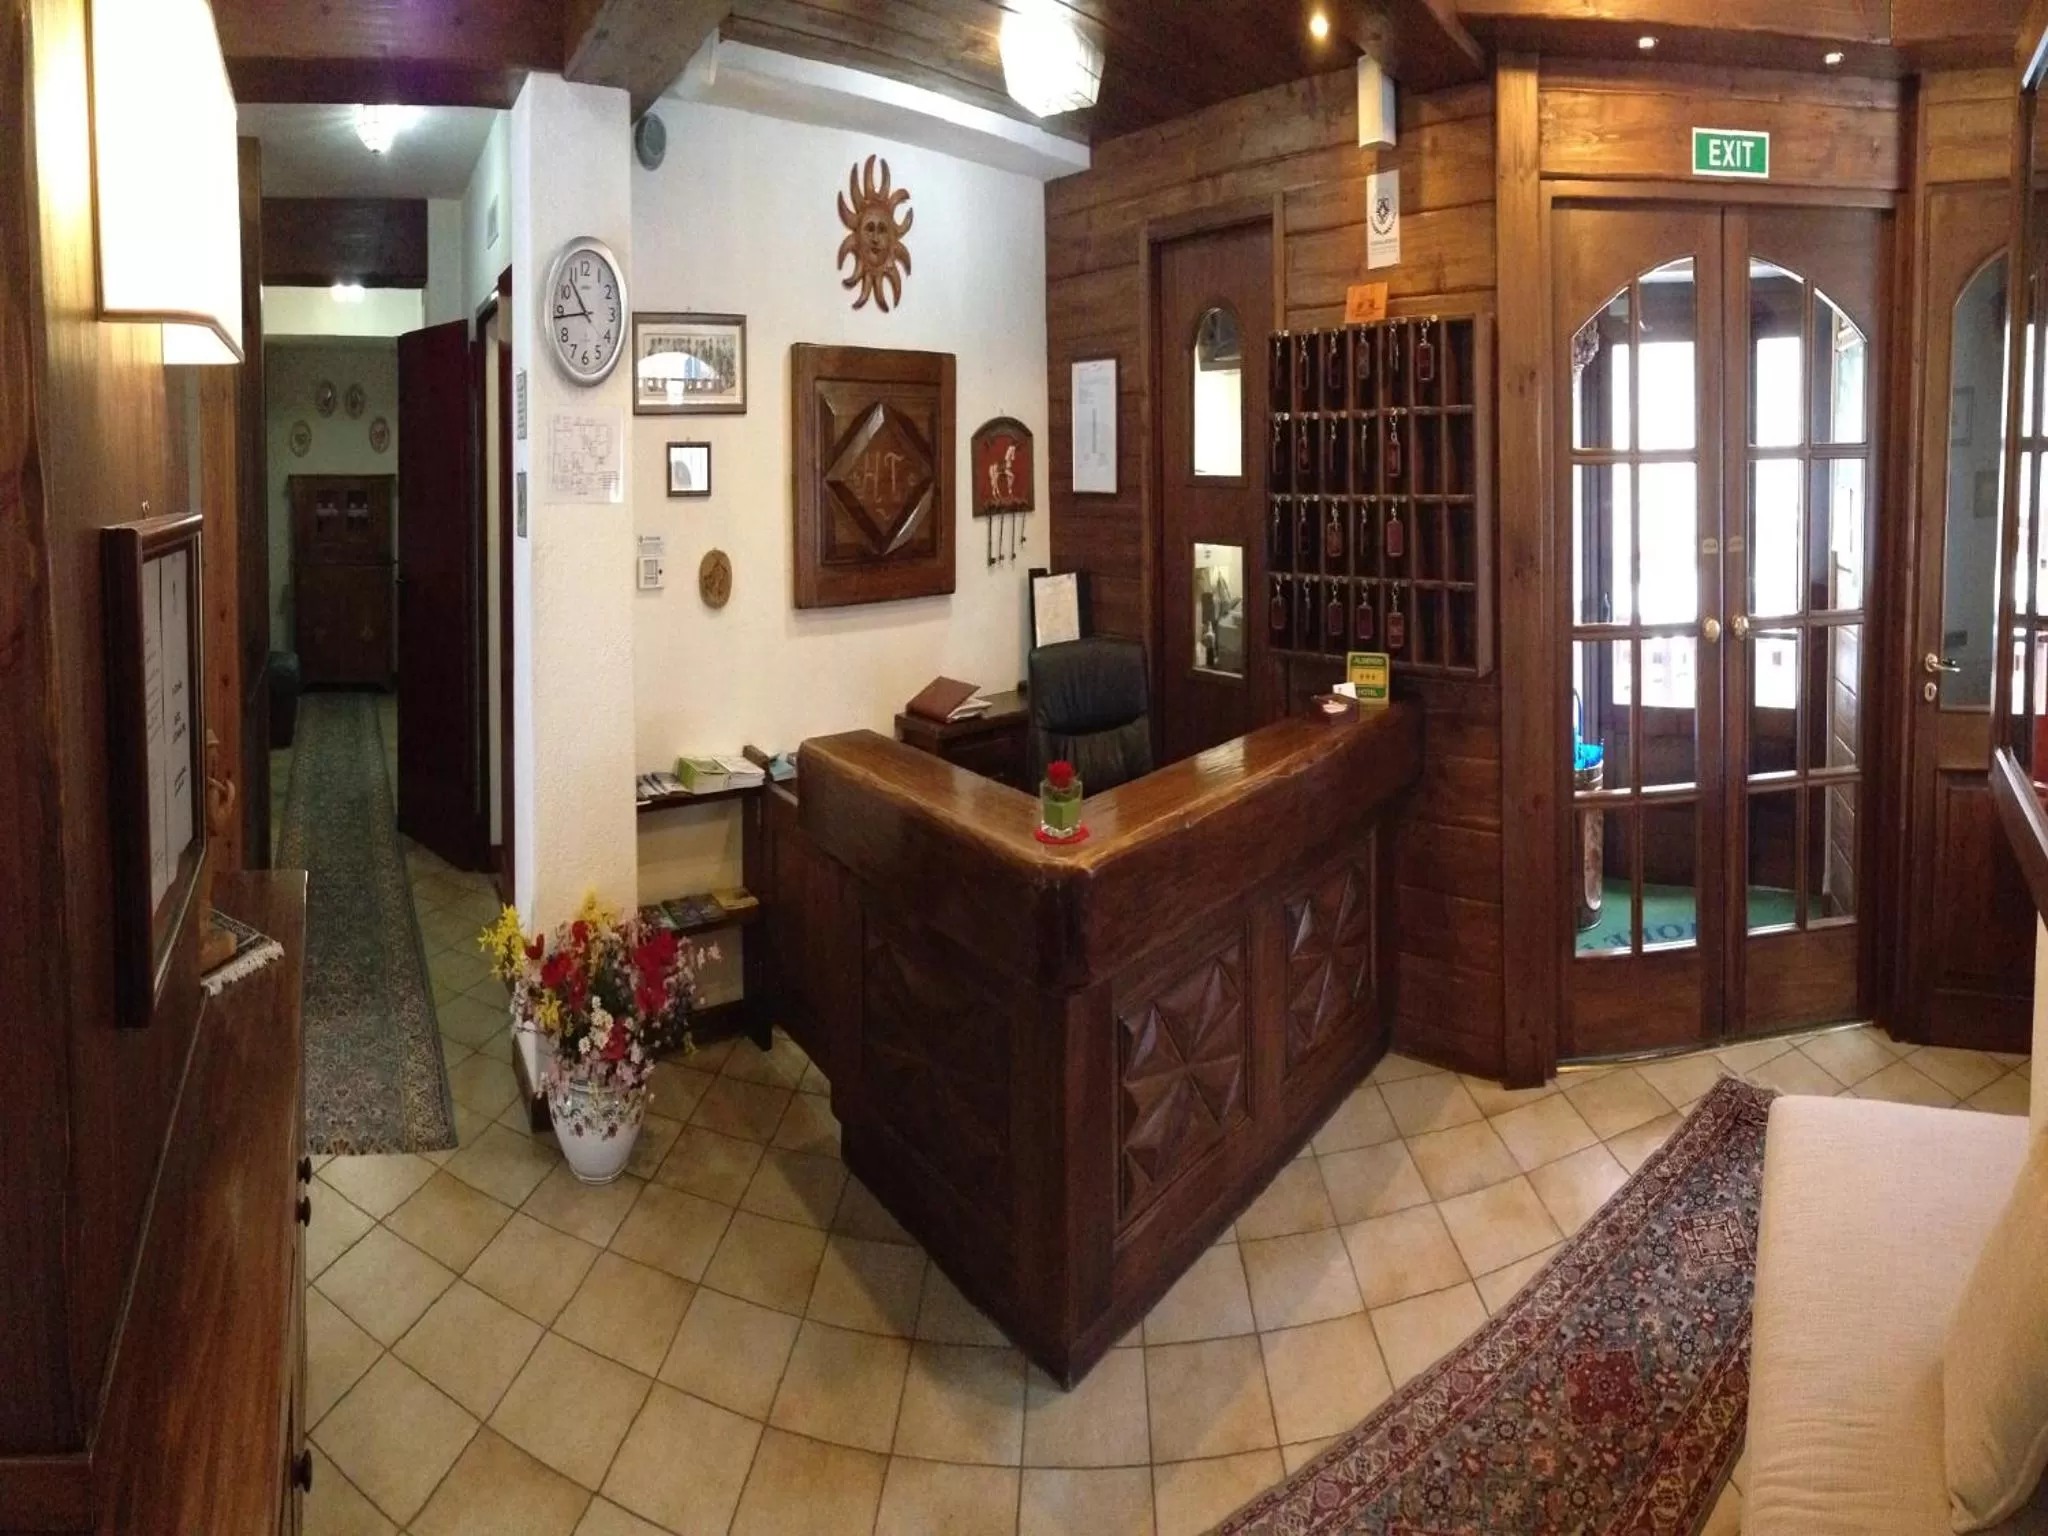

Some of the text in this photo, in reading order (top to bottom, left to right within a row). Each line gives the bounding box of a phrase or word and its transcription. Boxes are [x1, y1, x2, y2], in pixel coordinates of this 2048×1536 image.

[1709, 139, 1755, 168] EXIT
[580, 260, 591, 277] 12
[561, 284, 572, 300] 10
[604, 284, 613, 300] 2
[556, 304, 565, 318] 9
[608, 308, 616, 323] 3
[560, 327, 569, 343] 8
[603, 330, 611, 344] 4
[570, 344, 577, 359] 7
[581, 351, 590, 366] 6
[595, 345, 602, 360] 5
